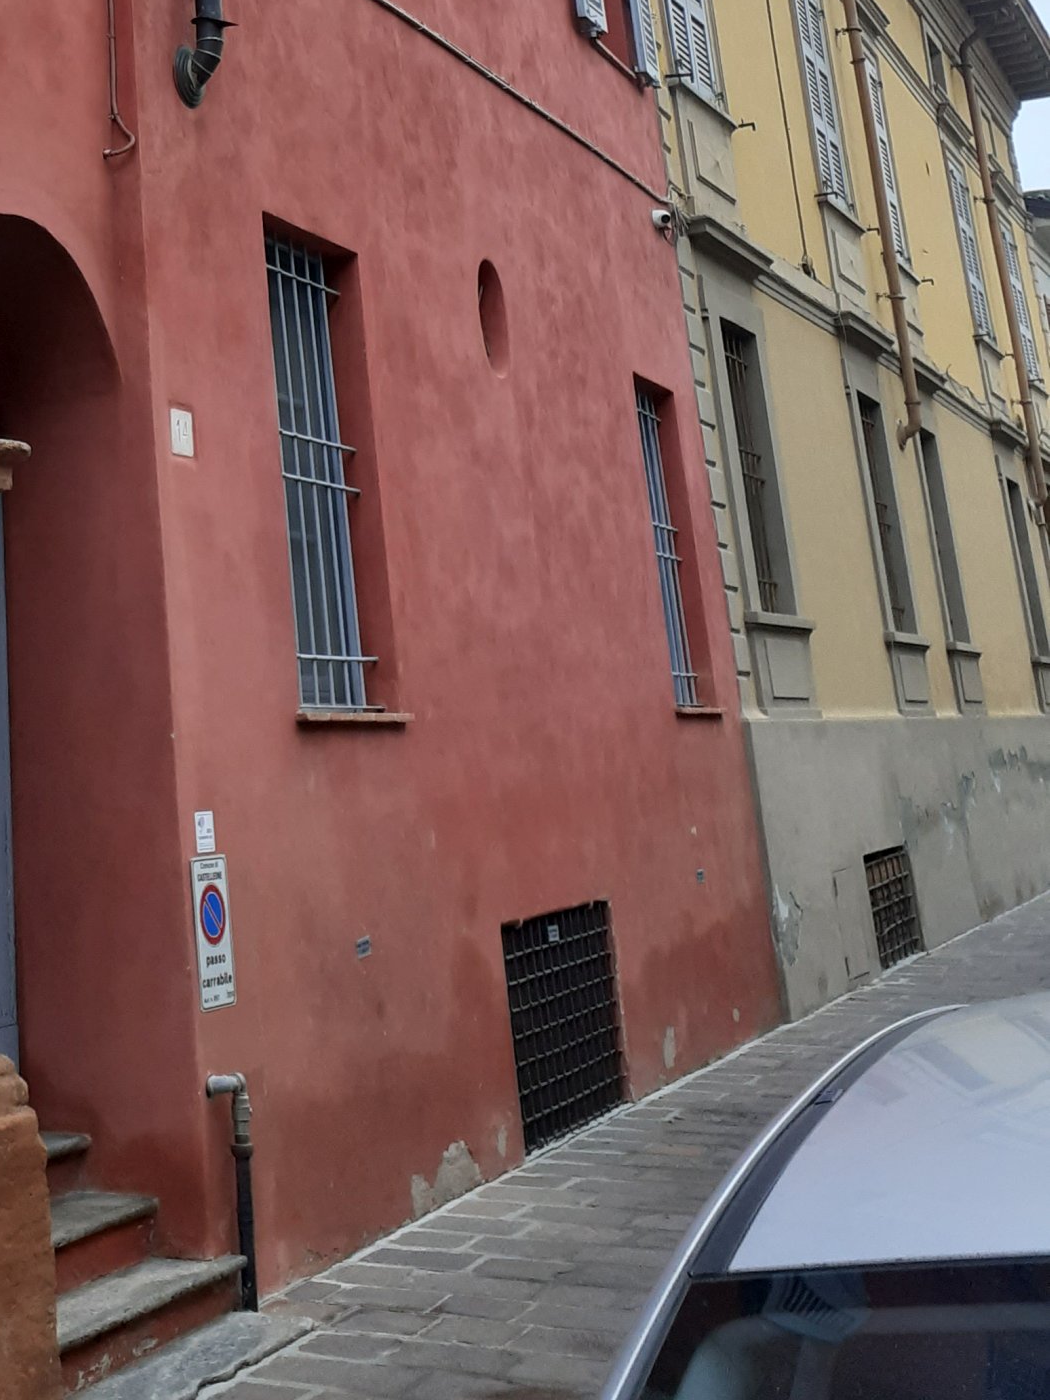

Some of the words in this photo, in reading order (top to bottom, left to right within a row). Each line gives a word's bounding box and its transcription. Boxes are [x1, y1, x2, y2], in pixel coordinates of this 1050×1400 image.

[175, 419, 189, 444] 14
[206, 953, 227, 969] passo
[202, 971, 232, 989] carrabile
